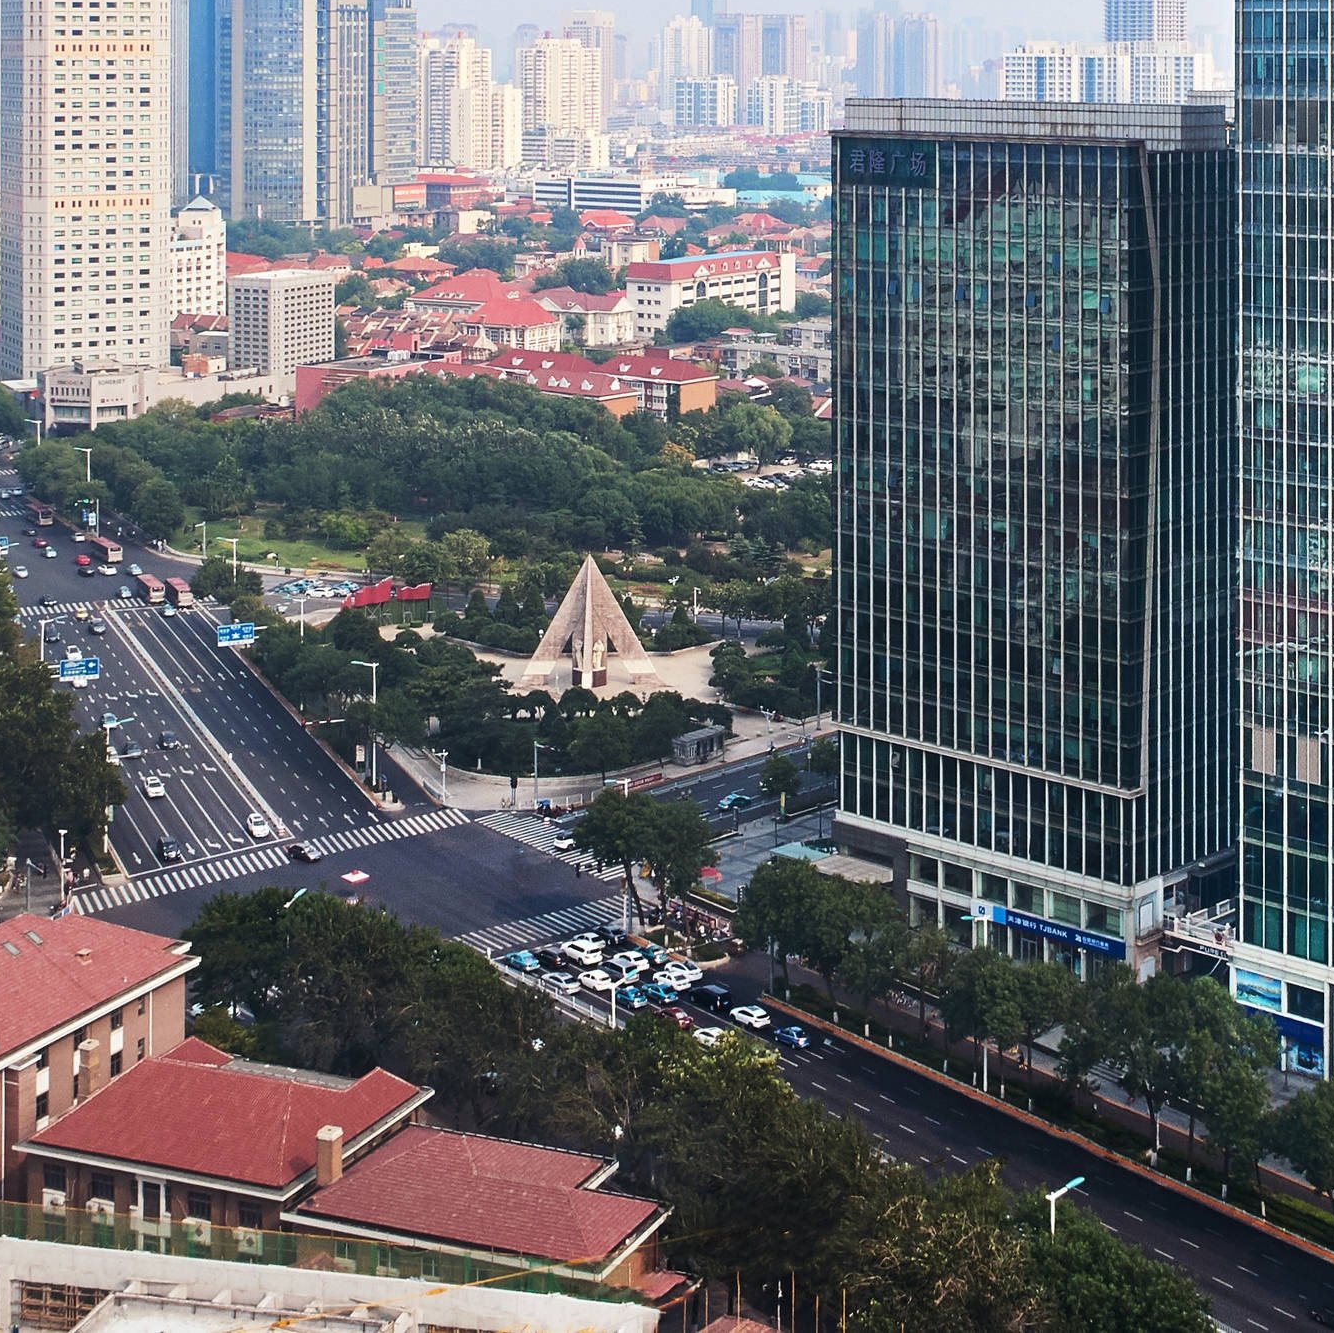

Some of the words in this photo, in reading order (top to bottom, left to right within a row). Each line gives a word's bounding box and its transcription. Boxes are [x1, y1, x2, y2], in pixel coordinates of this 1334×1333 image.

[850, 149, 927, 177] 君隆广场
[1007, 914, 1037, 929] 天津银行
[1039, 924, 1068, 938] TJBANK
